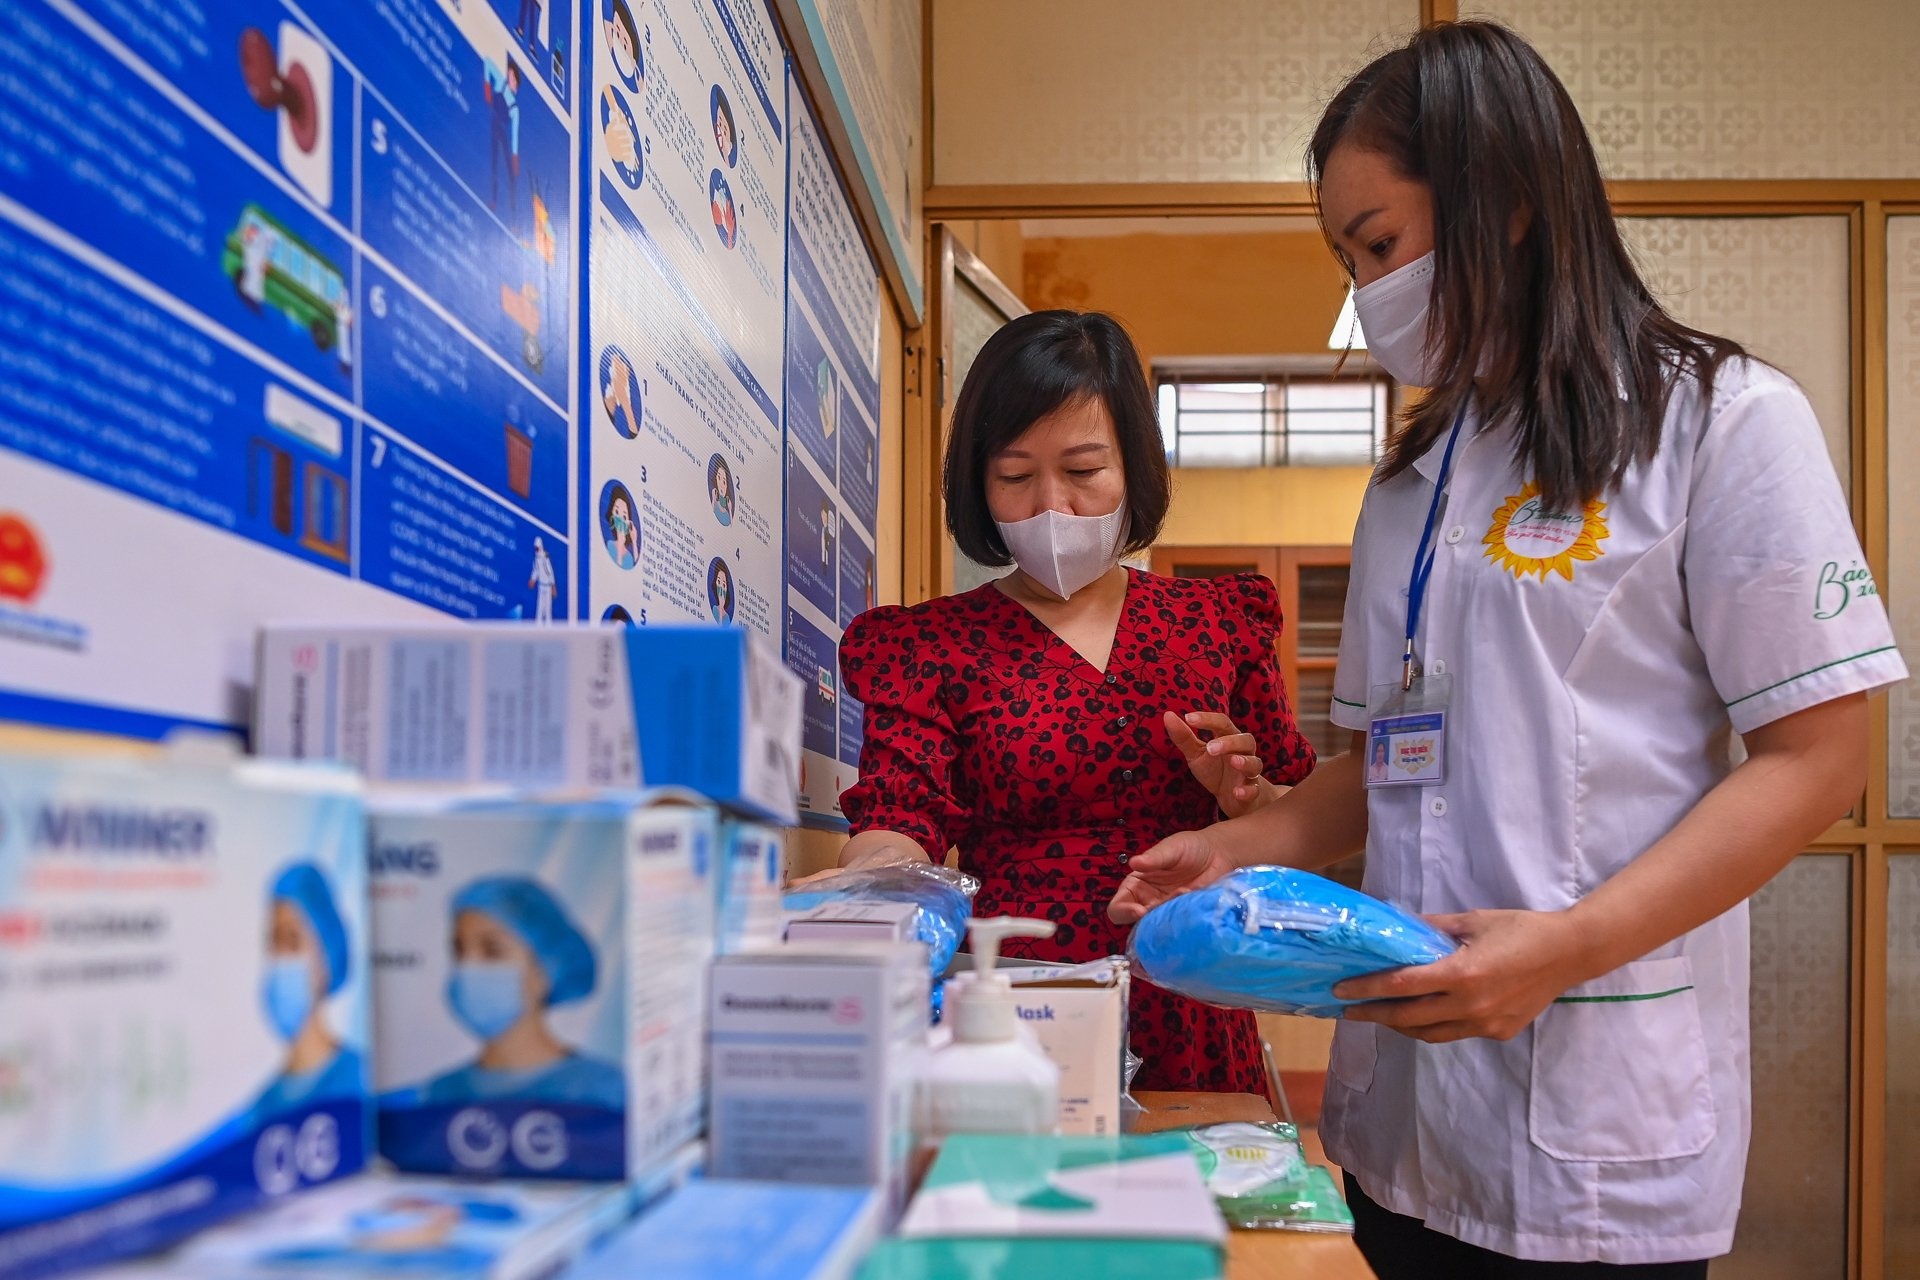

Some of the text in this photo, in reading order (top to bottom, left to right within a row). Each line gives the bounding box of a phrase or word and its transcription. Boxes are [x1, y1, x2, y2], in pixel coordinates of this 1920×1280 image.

[645, 21, 650, 47] 3
[371, 118, 388, 155] 5
[645, 133, 650, 157] 5
[740, 126, 744, 148] 2
[739, 198, 744, 219] 4
[370, 284, 387, 320] 6
[643, 377, 647, 396] 1
[370, 434, 387, 469] 7
[732, 441, 734, 454] 1
[641, 464, 646, 484] 3
[736, 474, 740, 490] 2
[735, 545, 739, 562] 4
[1813, 561, 1868, 620] Bảo
[640, 607, 646, 626] 5
[790, 611, 793, 625] 5
